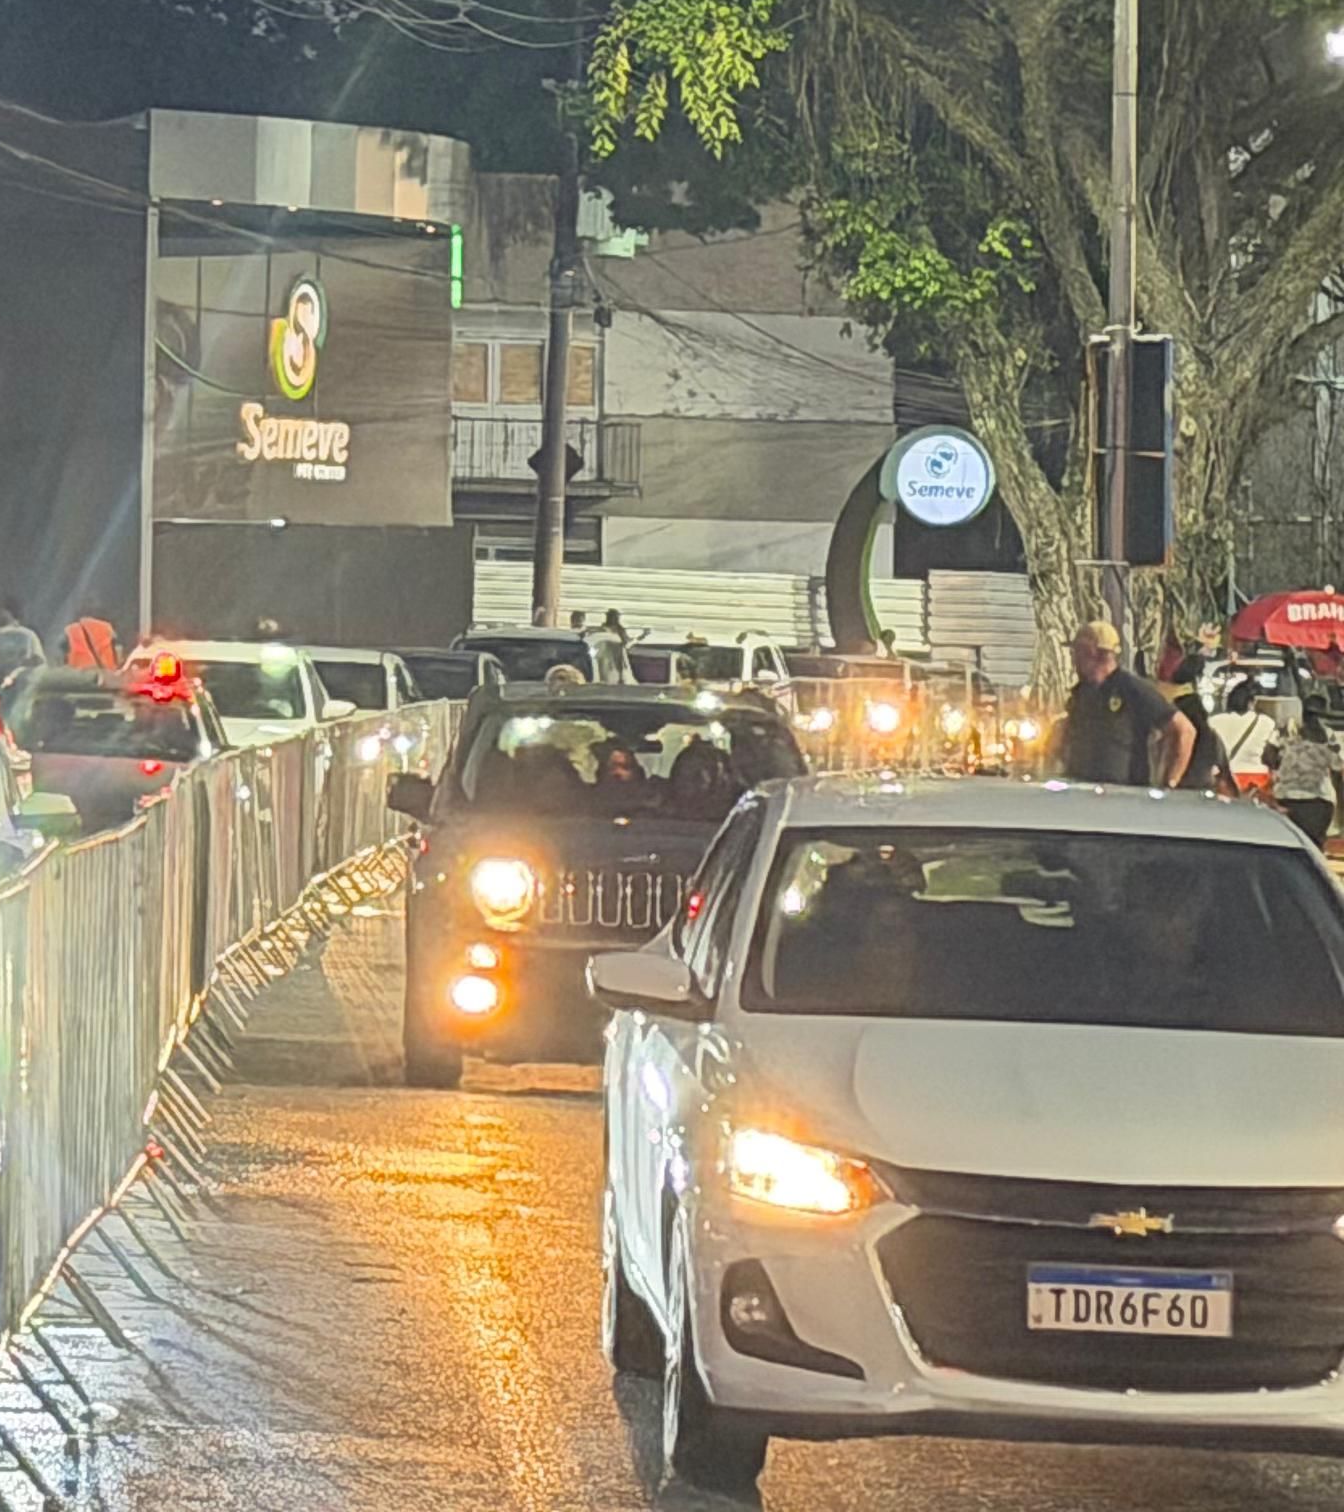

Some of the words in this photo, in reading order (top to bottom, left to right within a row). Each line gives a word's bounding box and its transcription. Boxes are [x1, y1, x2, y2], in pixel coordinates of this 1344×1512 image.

[236, 402, 351, 464] Semeve
[906, 480, 976, 499] Semeve
[1048, 1287, 1209, 1329] TDR6F60
